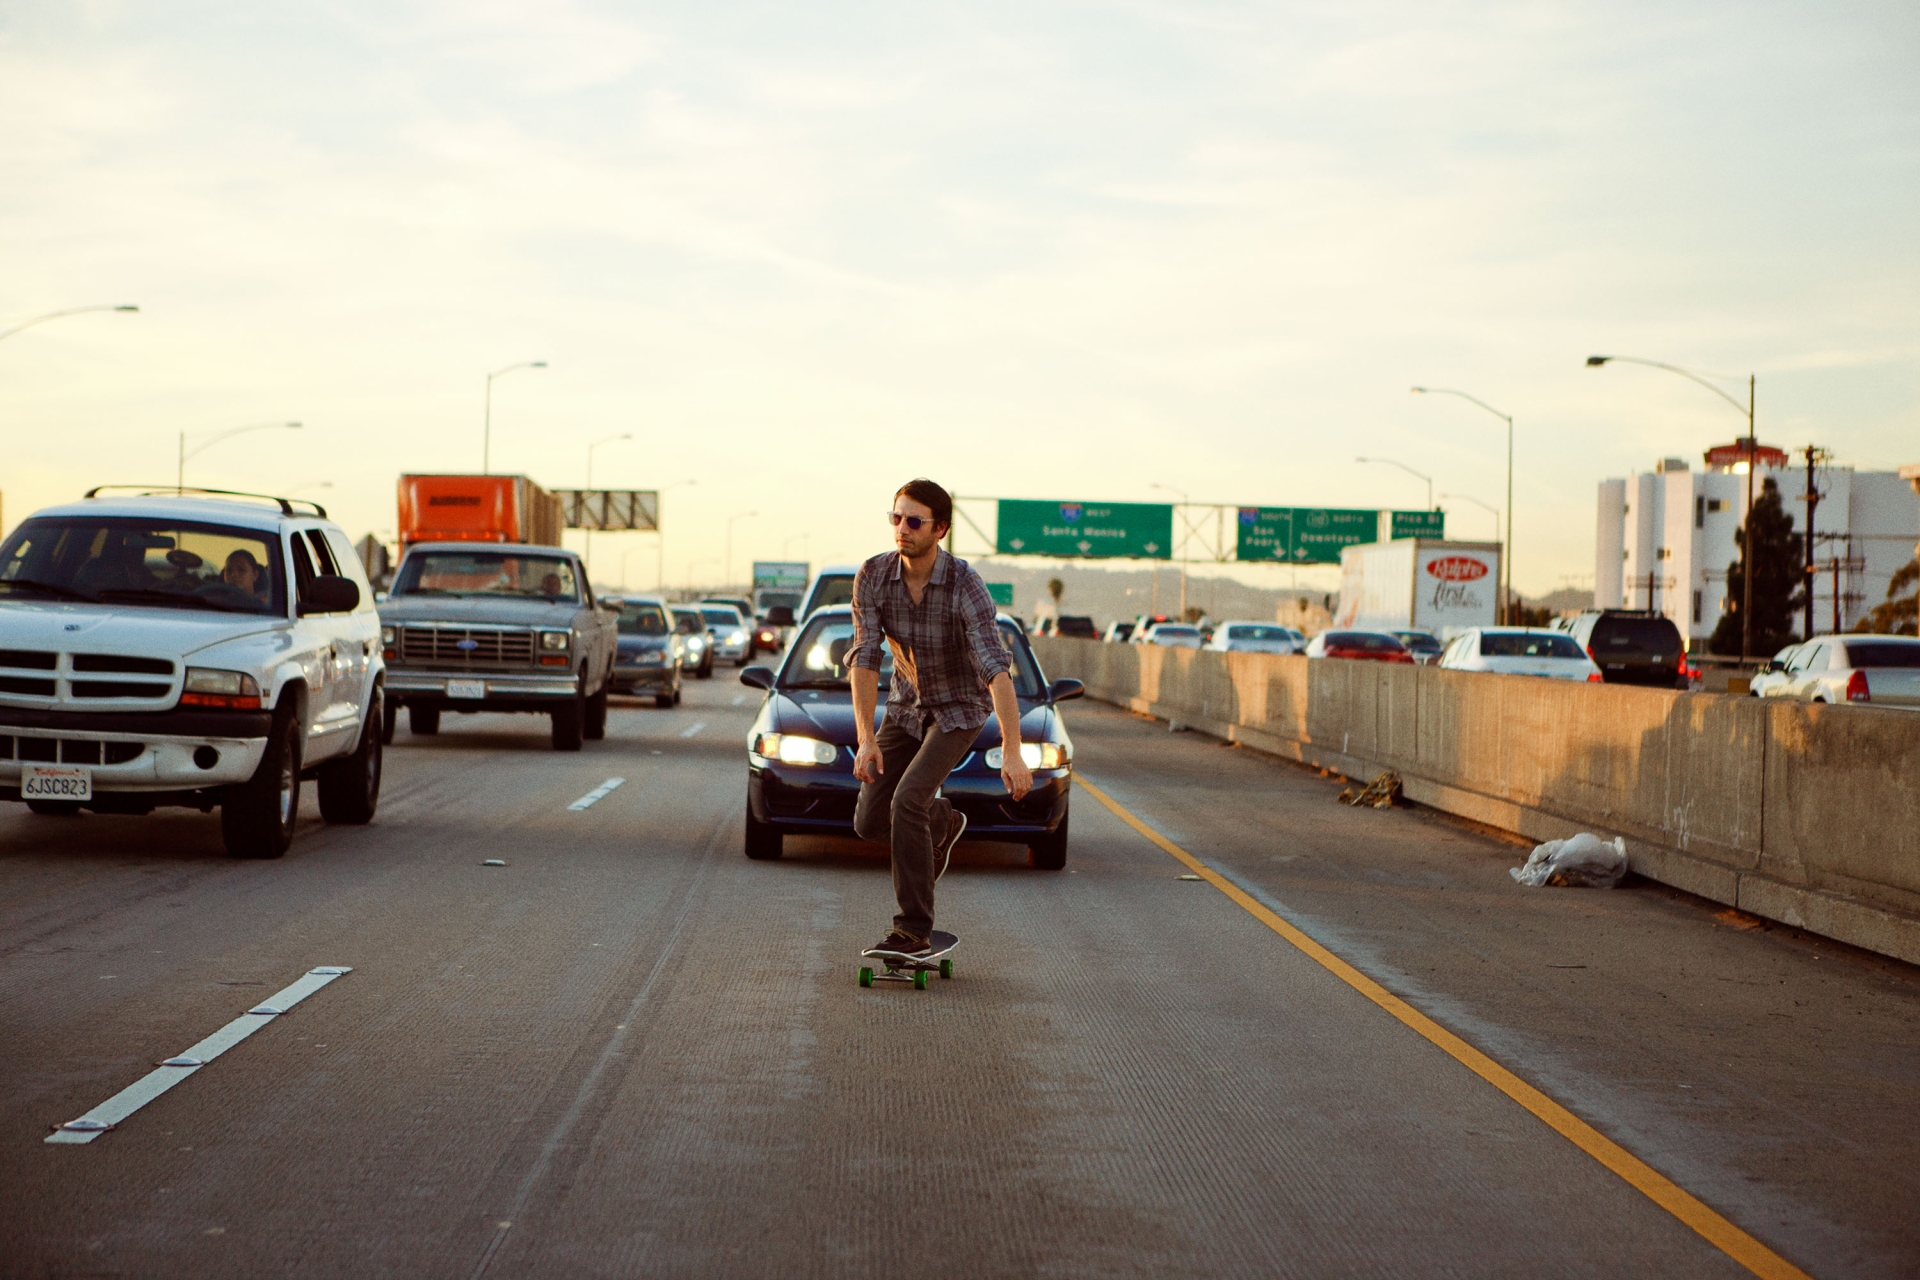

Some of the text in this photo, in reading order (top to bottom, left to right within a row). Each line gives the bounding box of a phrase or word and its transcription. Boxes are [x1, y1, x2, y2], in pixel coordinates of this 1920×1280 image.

[1043, 525, 1127, 539] Santa Monica
[1253, 526, 1275, 536] San
[1300, 532, 1361, 544] Downtown
[26, 778, 87, 796] 6JSC823
